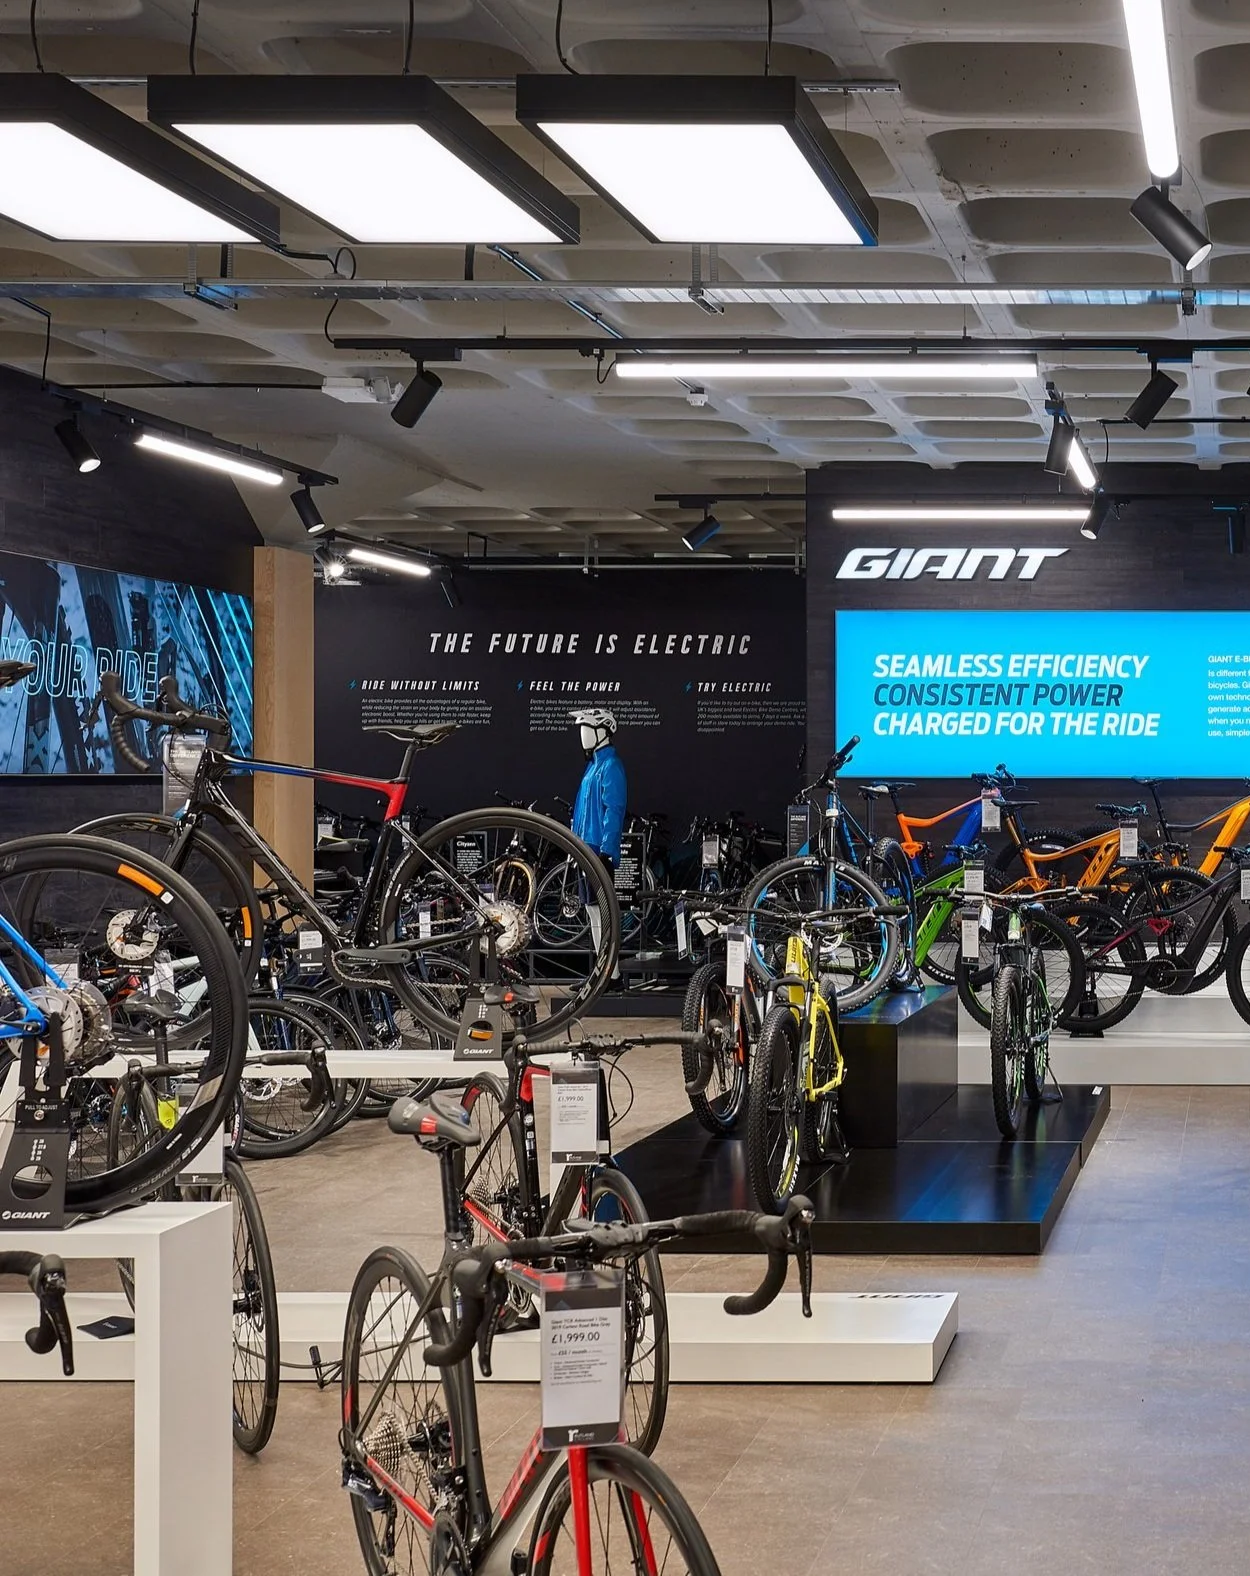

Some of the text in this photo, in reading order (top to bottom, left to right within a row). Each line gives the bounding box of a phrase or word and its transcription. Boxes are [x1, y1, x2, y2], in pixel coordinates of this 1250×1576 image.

[835, 547, 1071, 581] GIANT
[429, 632, 753, 656] THE FUTURE IS ELECTRIC
[1208, 655, 1233, 663] GIANT
[1, 637, 88, 697] YOUR
[873, 654, 1150, 678] SEAMLESS EFFICIENCY
[361, 680, 480, 690] RIDE WITHOUT LIMITS
[529, 681, 620, 691] FEEL THE POWER
[698, 682, 771, 692] TRY ELECTRIC
[1208, 681, 1240, 690] bicycles.
[873, 683, 1124, 707] CONSISTENT POWER
[1208, 705, 1241, 714] generate
[873, 711, 1160, 737] CHARGED FOR THE RIDE
[1208, 716, 1228, 724] when
[1230, 718, 1244, 726] you
[1208, 730, 1224, 738] use,
[1225, 728, 1250, 738] simple
[552, 1331, 600, 1344] £1,999.00
